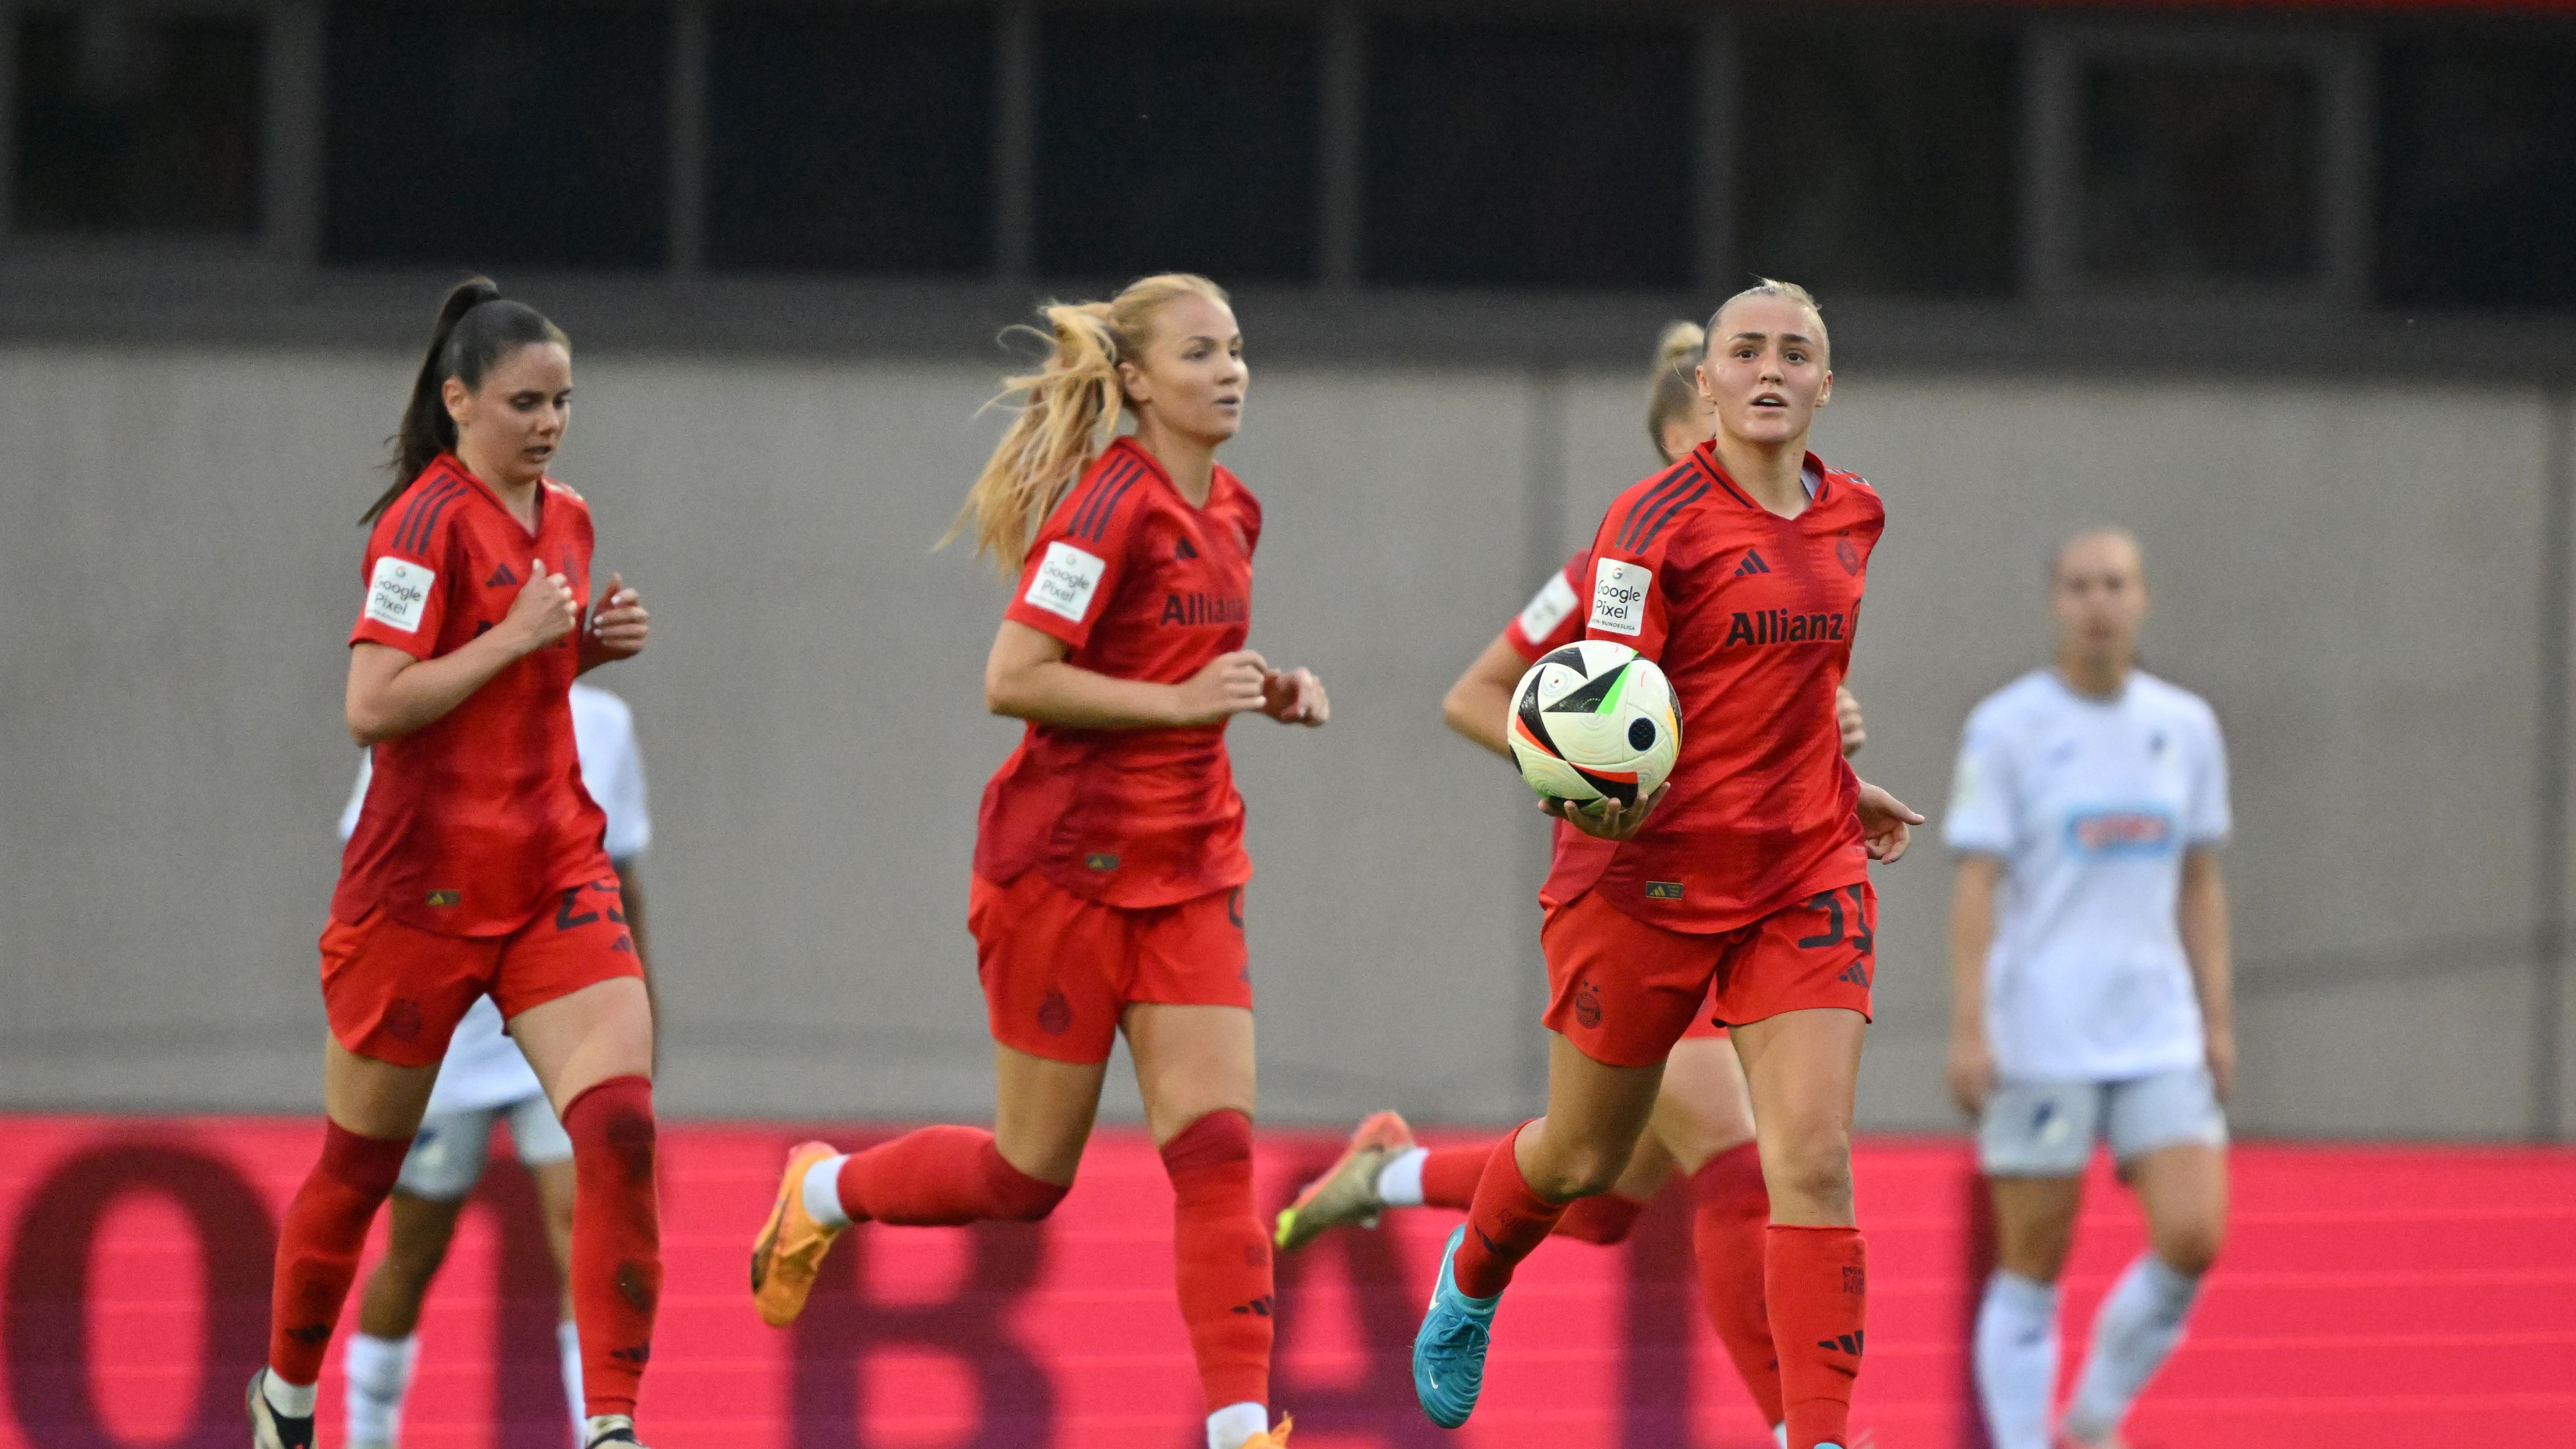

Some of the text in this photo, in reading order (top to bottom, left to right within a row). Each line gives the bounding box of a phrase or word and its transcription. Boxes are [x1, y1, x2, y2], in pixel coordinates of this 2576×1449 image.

[1612, 567, 1623, 580] G
[375, 575, 421, 601] Google
[1597, 580, 1641, 604] Google
[375, 592, 408, 615] Pixel
[1594, 599, 1628, 619] Pixel
[1725, 607, 1844, 647] Allianz
